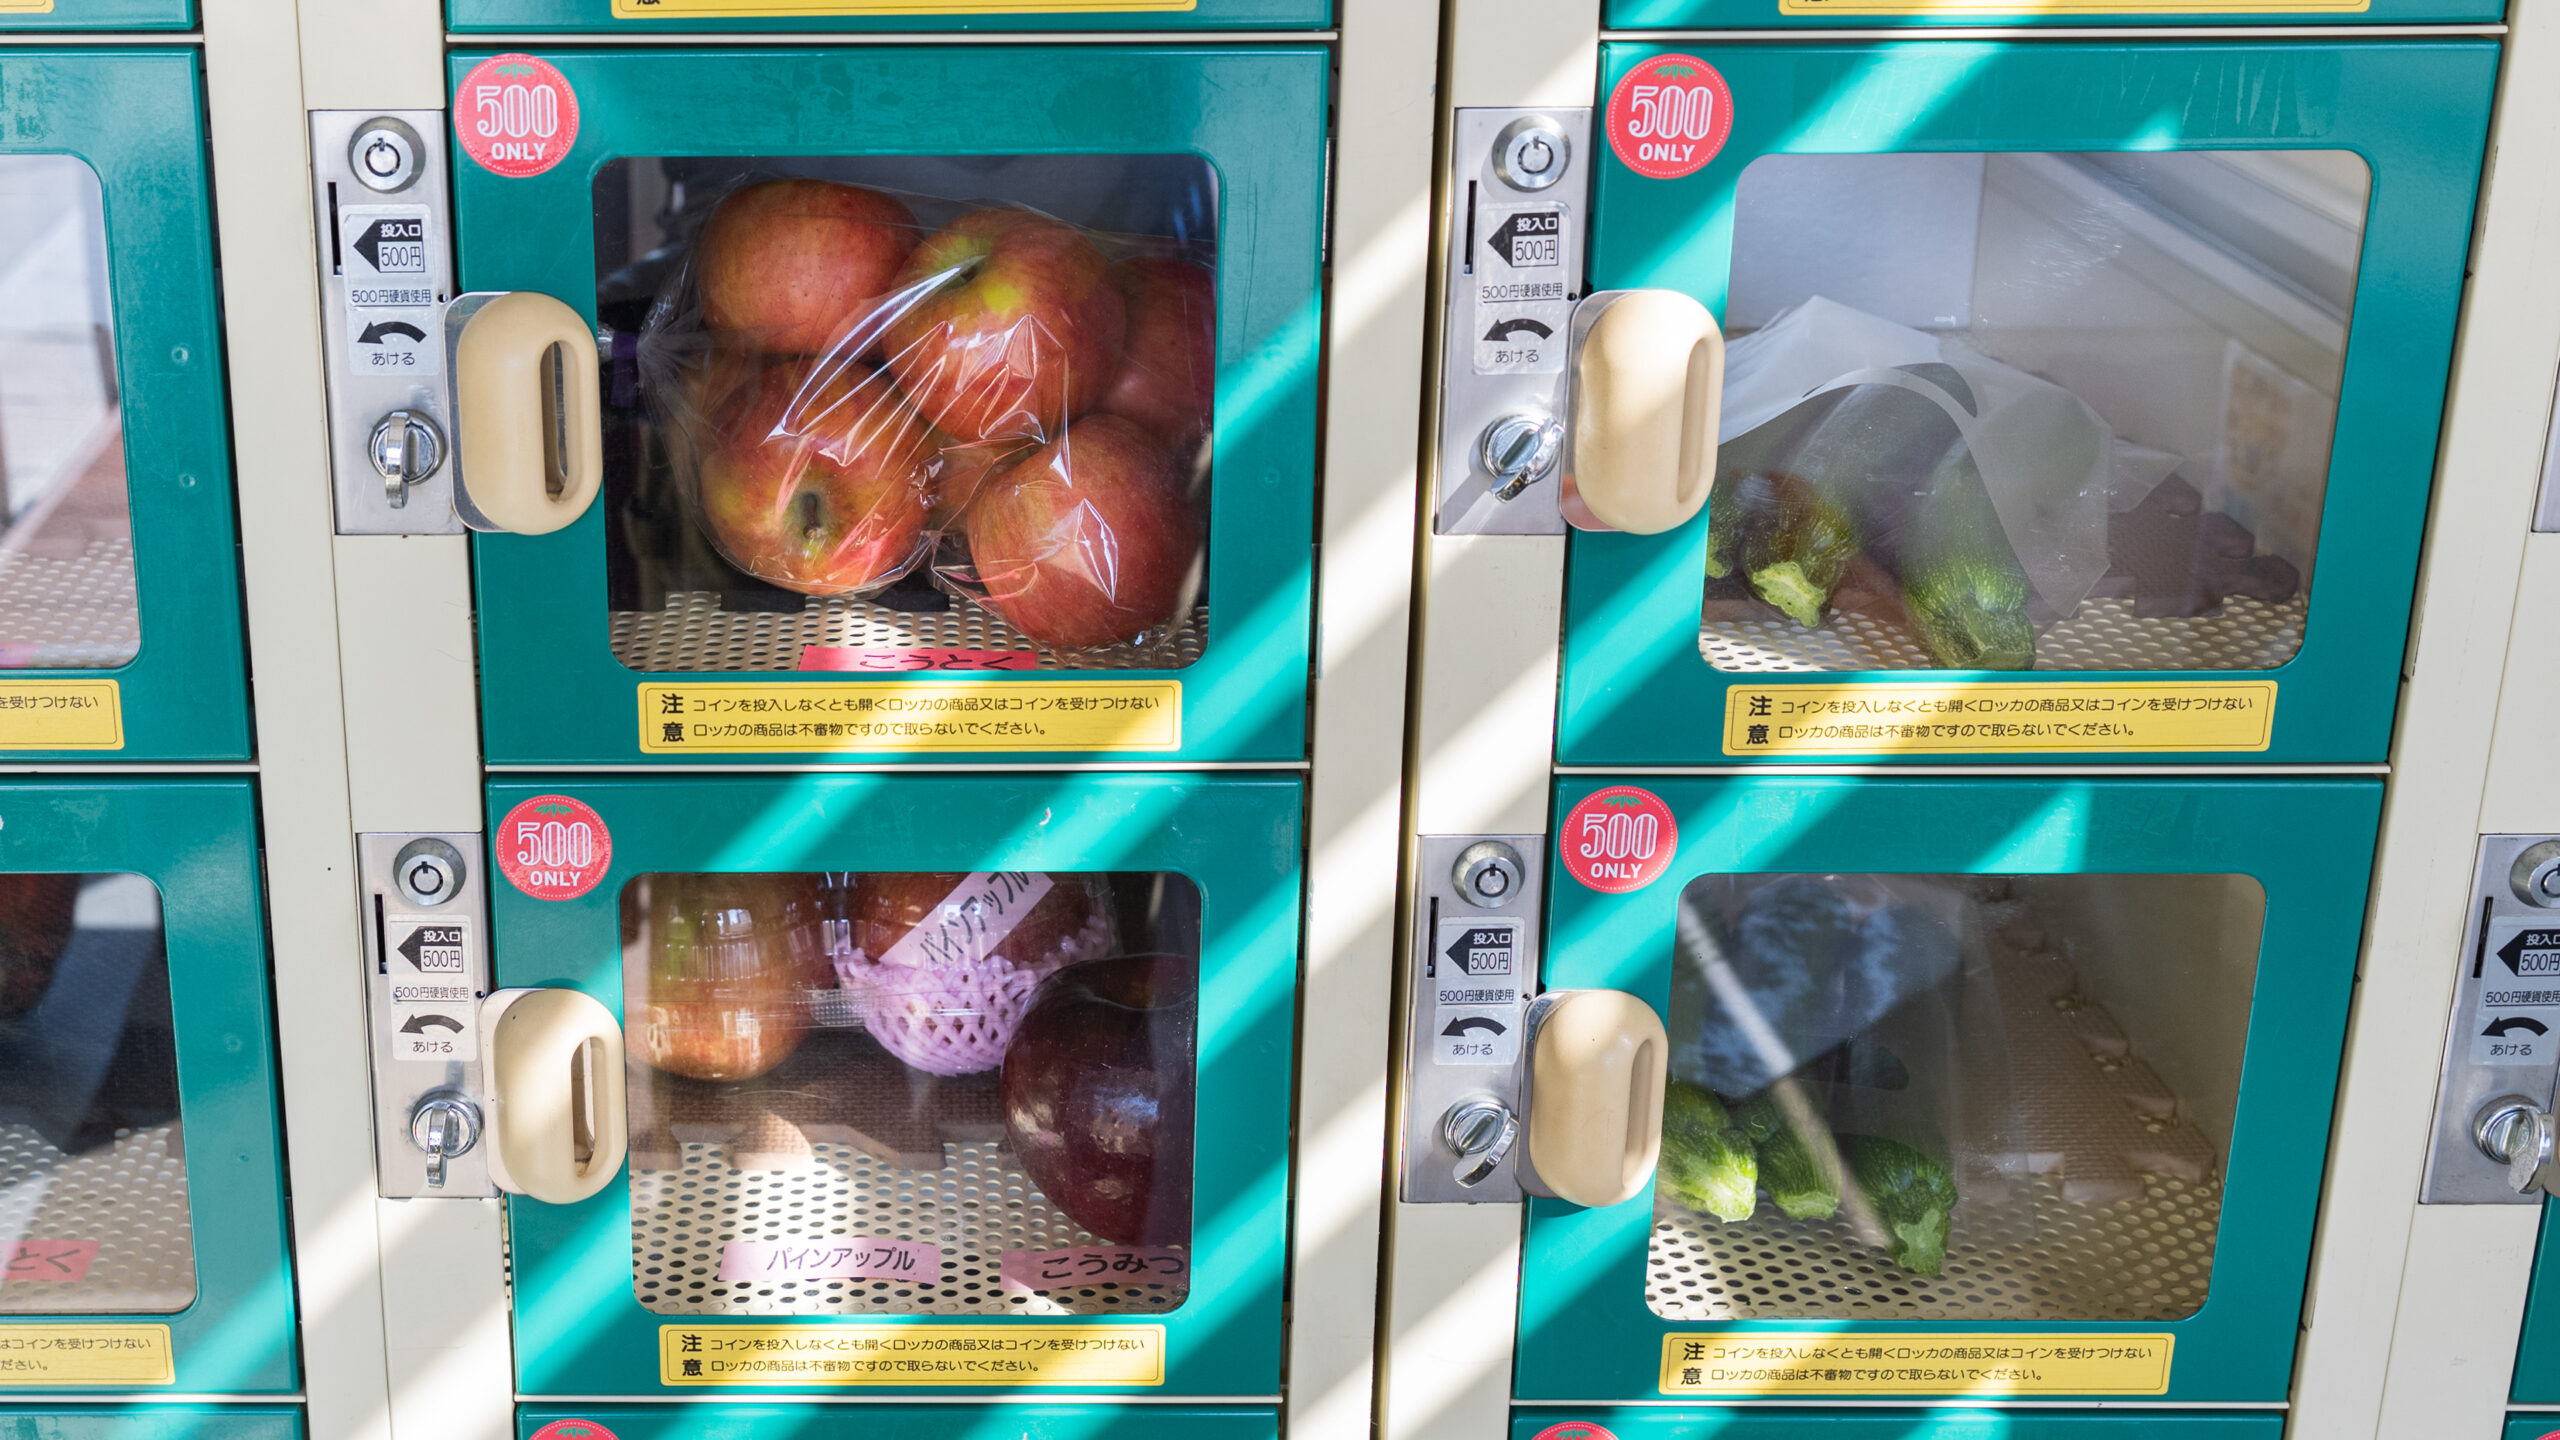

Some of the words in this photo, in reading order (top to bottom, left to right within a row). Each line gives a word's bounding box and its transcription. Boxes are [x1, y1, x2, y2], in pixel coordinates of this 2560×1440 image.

[476, 85, 558, 139] 500
[1628, 85, 1713, 140] 500
[491, 142, 546, 161] ONLY
[1638, 143, 1696, 162] ONLY
[380, 224, 421, 237] 投入口
[1516, 217, 1557, 232] 投入口
[381, 246, 422, 267] 500円
[1515, 239, 1556, 260] 500円
[352, 289, 432, 303] 500円硬貨使用
[1482, 282, 1563, 299] 500円硬貨使用
[372, 352, 415, 365] あける
[1495, 350, 1539, 363] あける
[860, 654, 1013, 671] こうとく
[517, 821, 592, 867] 500
[1580, 813, 1658, 859] 500
[530, 871, 581, 886] ONLY
[1590, 863, 1643, 878] ONLY
[423, 930, 461, 942] 投入口
[1473, 933, 1511, 945] 投入口
[423, 950, 461, 968] 500円
[1471, 951, 1509, 970] 500円
[2521, 953, 2560, 971] 500円
[394, 986, 468, 999] 500円硬貨使用
[1440, 989, 1514, 1002] 500円硬貨使用
[2485, 991, 2560, 1003] 500円硬貨使用
[412, 1041, 453, 1053] あける
[1452, 1043, 1493, 1056] あける
[2490, 1044, 2532, 1056] あける
[766, 1246, 916, 1271] パインアップル
[1041, 1253, 1185, 1280] こうみつ
